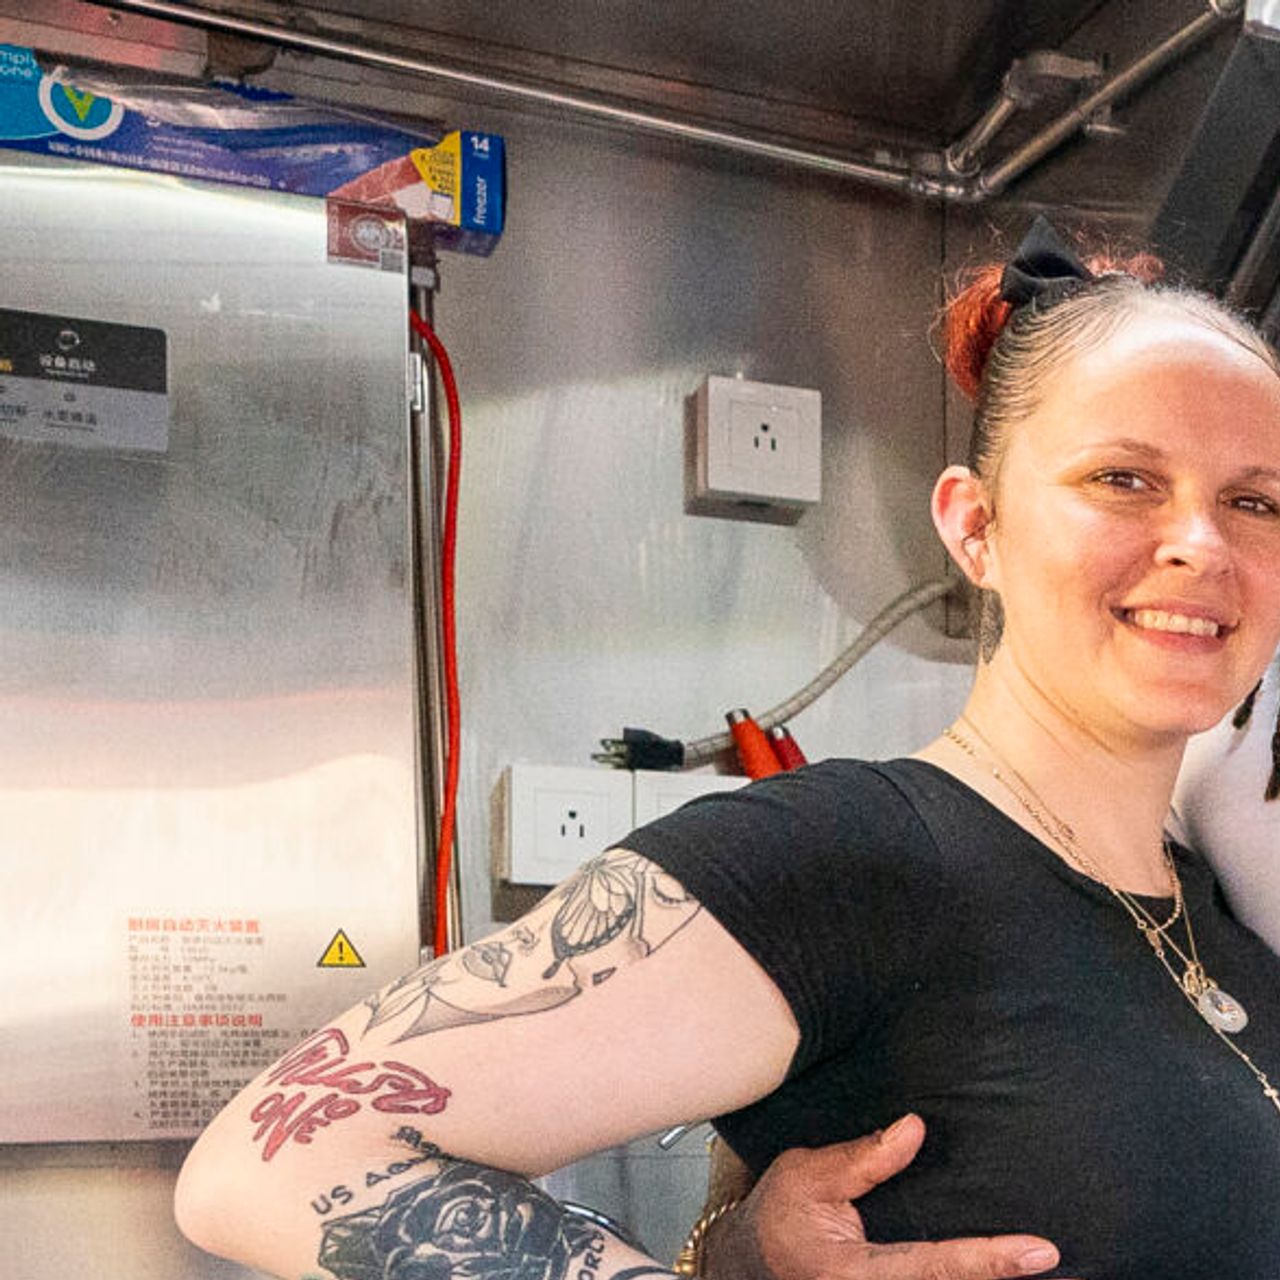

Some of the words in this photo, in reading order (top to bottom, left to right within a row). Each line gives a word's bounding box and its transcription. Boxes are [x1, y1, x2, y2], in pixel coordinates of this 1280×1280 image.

[470, 135, 491, 152] 14
[472, 176, 488, 226] freezer
[311, 1184, 354, 1215] US
